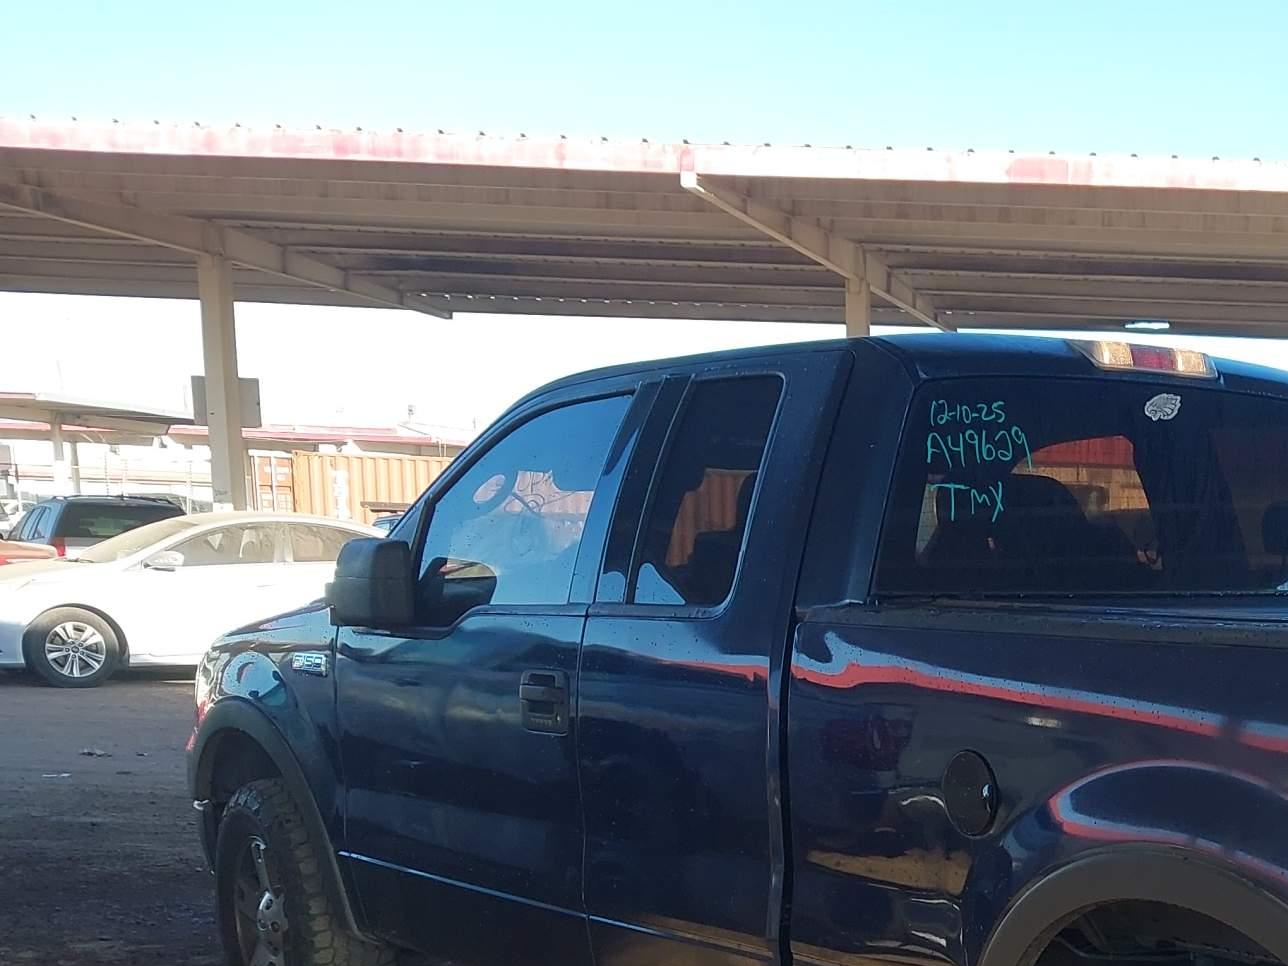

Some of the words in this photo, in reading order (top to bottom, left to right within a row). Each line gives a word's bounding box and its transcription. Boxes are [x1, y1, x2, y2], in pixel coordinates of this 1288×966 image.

[930, 400, 1005, 426] 12-10-25
[927, 426, 1032, 472] A49629
[928, 481, 1004, 522] TMX
